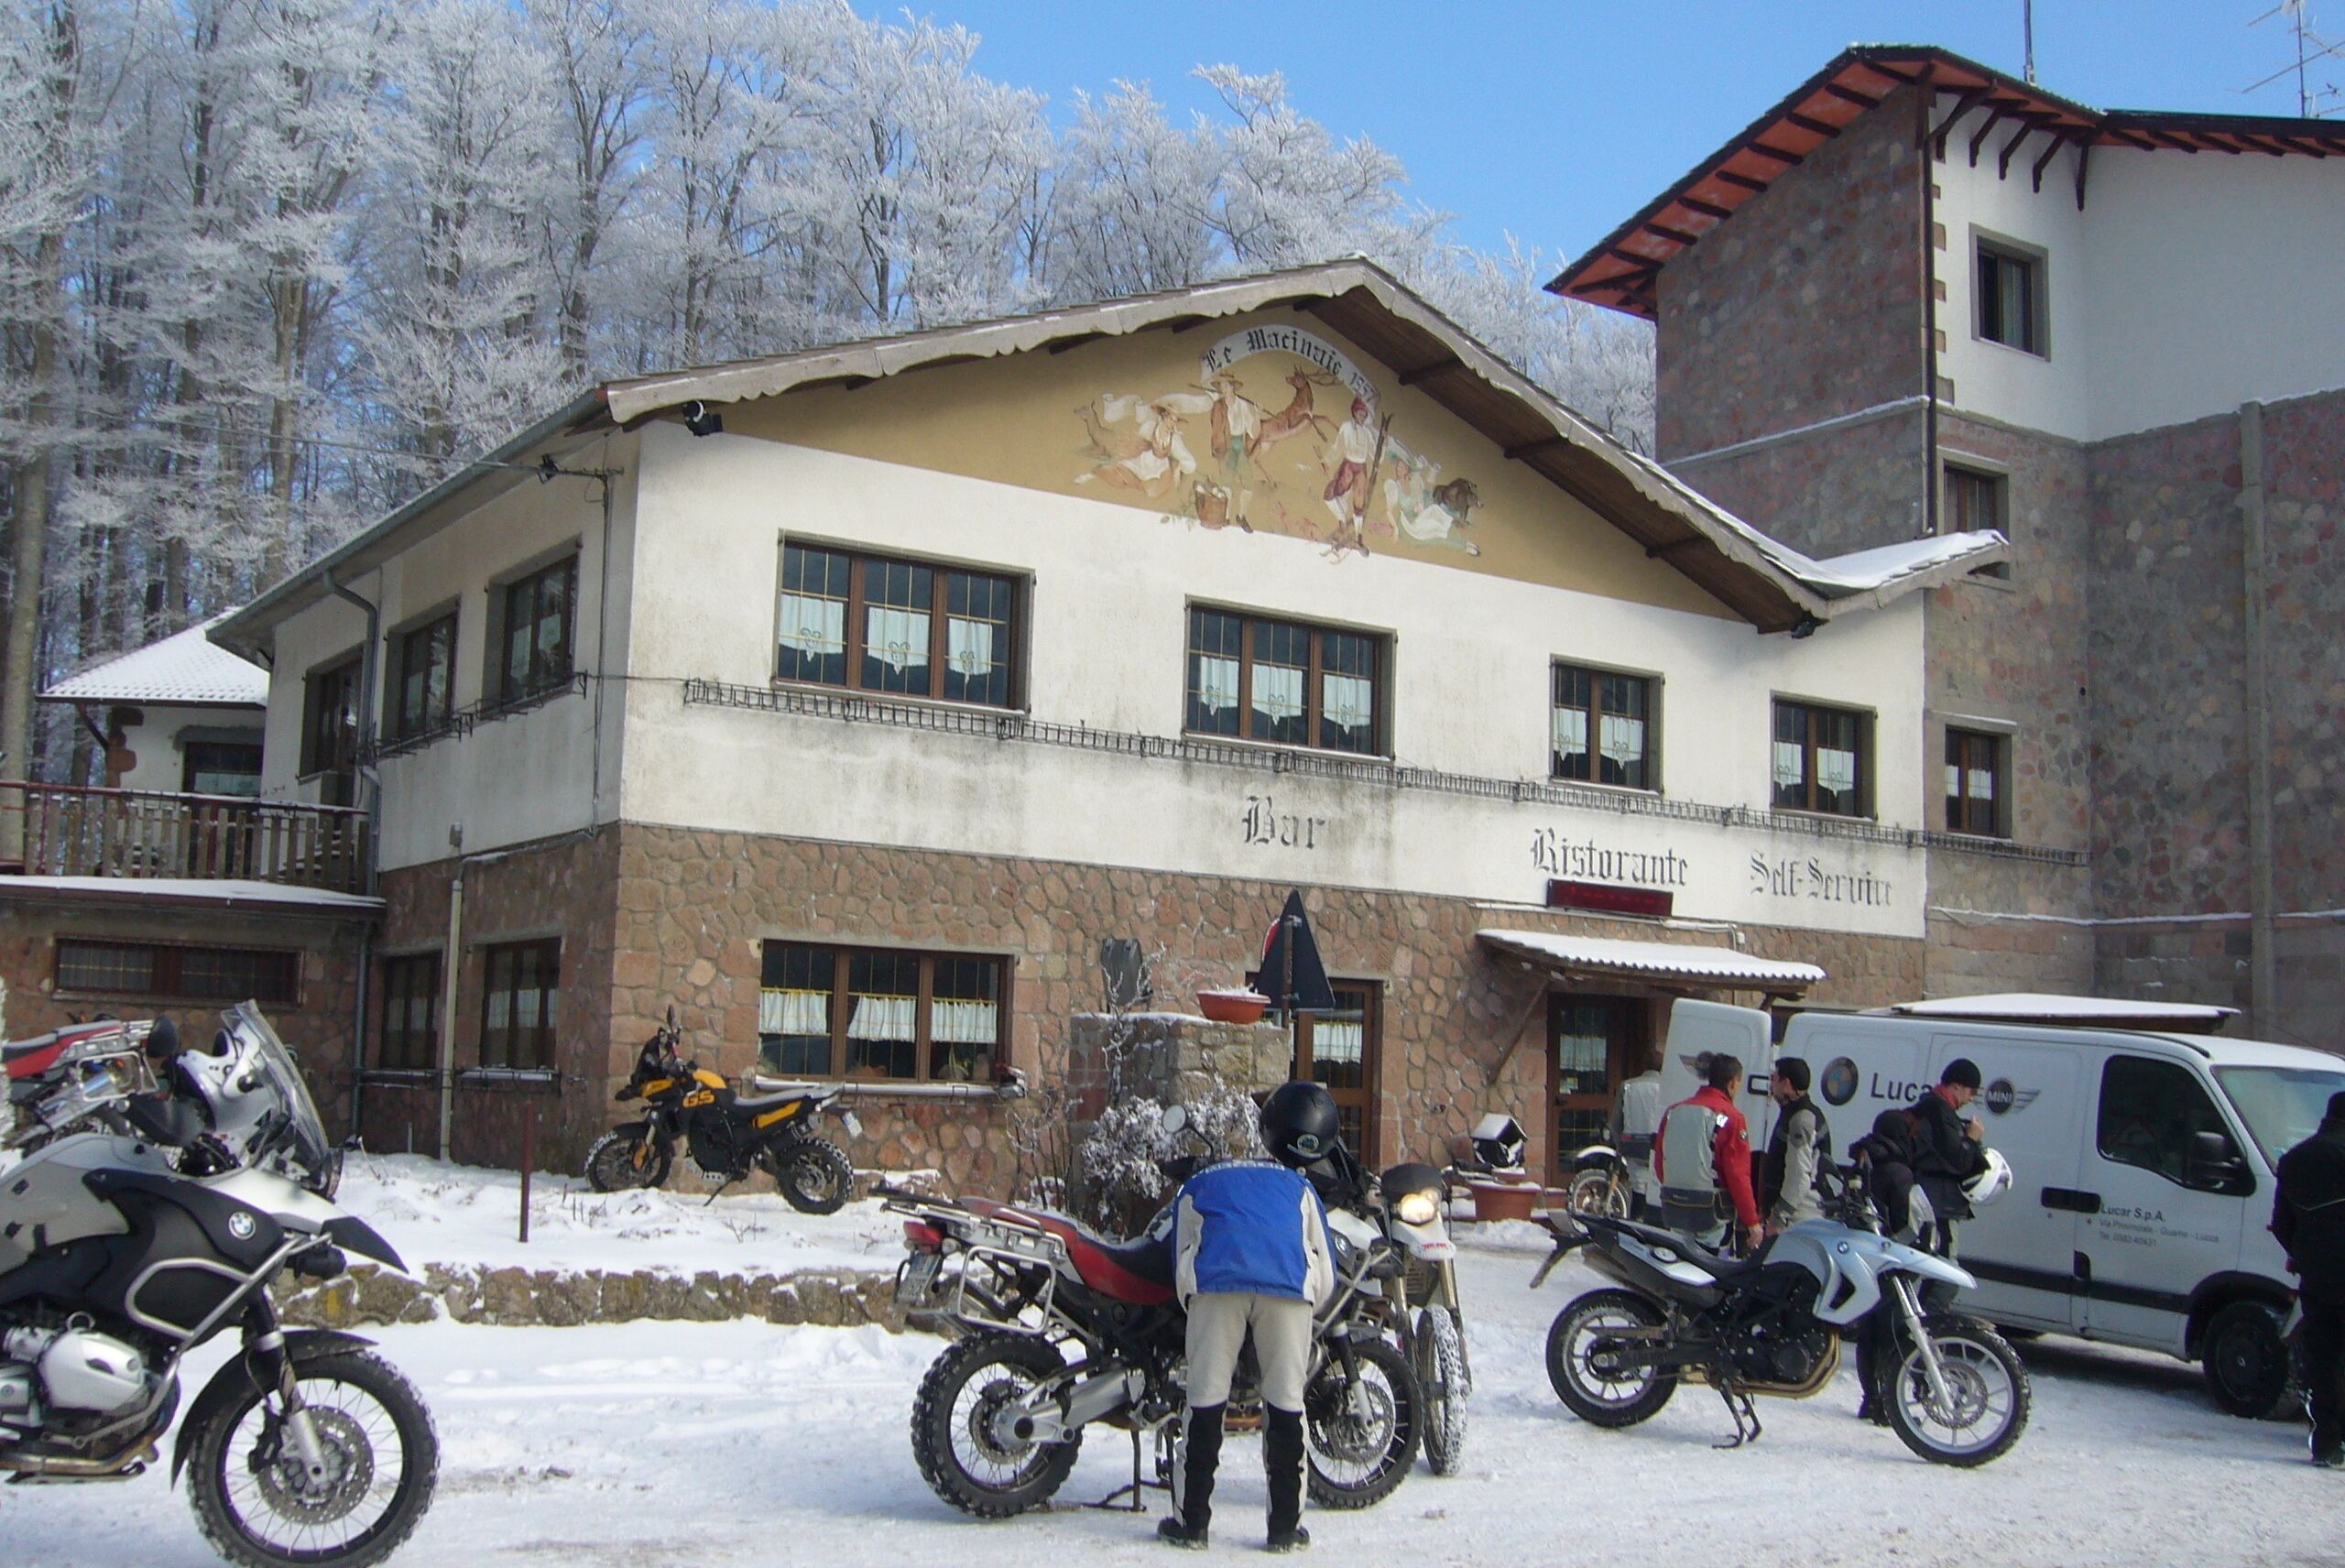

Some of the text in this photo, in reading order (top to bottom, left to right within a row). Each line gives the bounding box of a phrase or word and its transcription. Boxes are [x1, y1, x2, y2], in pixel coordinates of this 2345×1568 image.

[1202, 345, 1232, 373] Le
[1247, 328, 1342, 376] Macinaie
[1241, 795, 1325, 849] Bar
[1530, 827, 1688, 886] Ristorante
[682, 1088, 715, 1108] GS
[1988, 1089, 2013, 1105] MINI
[2101, 1203, 2165, 1223] Lucar S.p.A.
